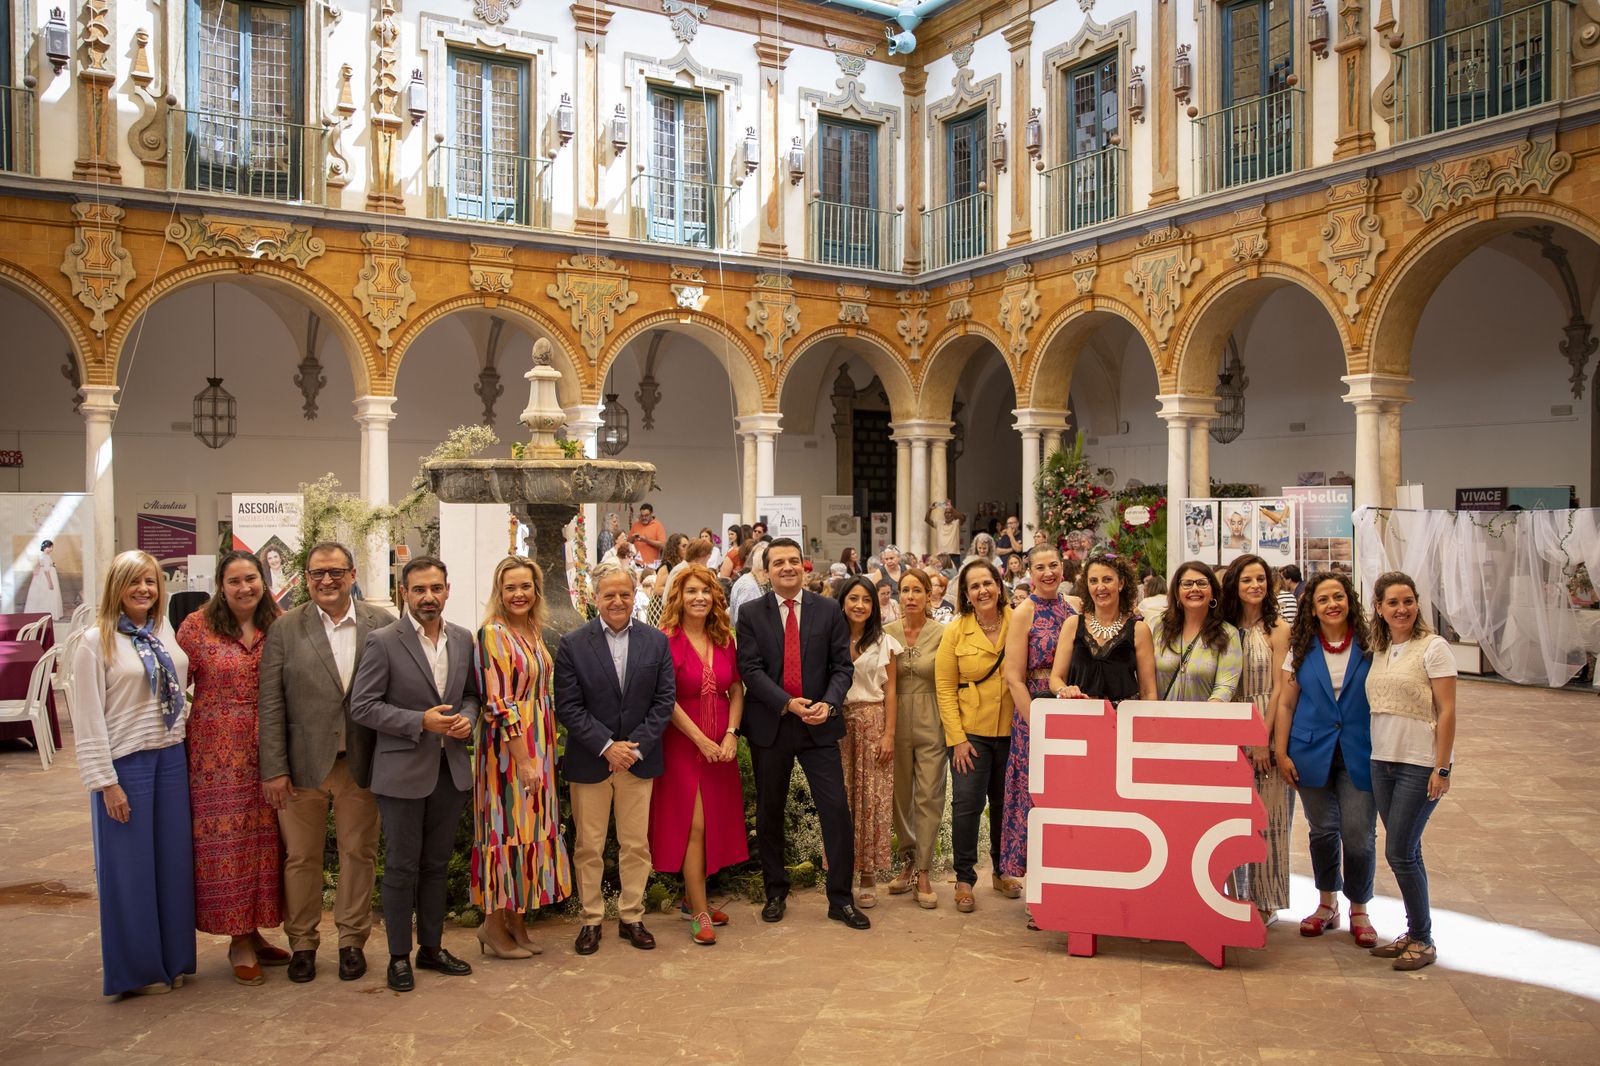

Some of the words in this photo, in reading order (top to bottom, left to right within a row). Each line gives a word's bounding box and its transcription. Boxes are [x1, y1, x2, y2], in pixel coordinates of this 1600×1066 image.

[1461, 491, 1502, 501] VIVACE
[238, 500, 284, 514] ASESORÍA
[1029, 697, 1253, 804] FE
